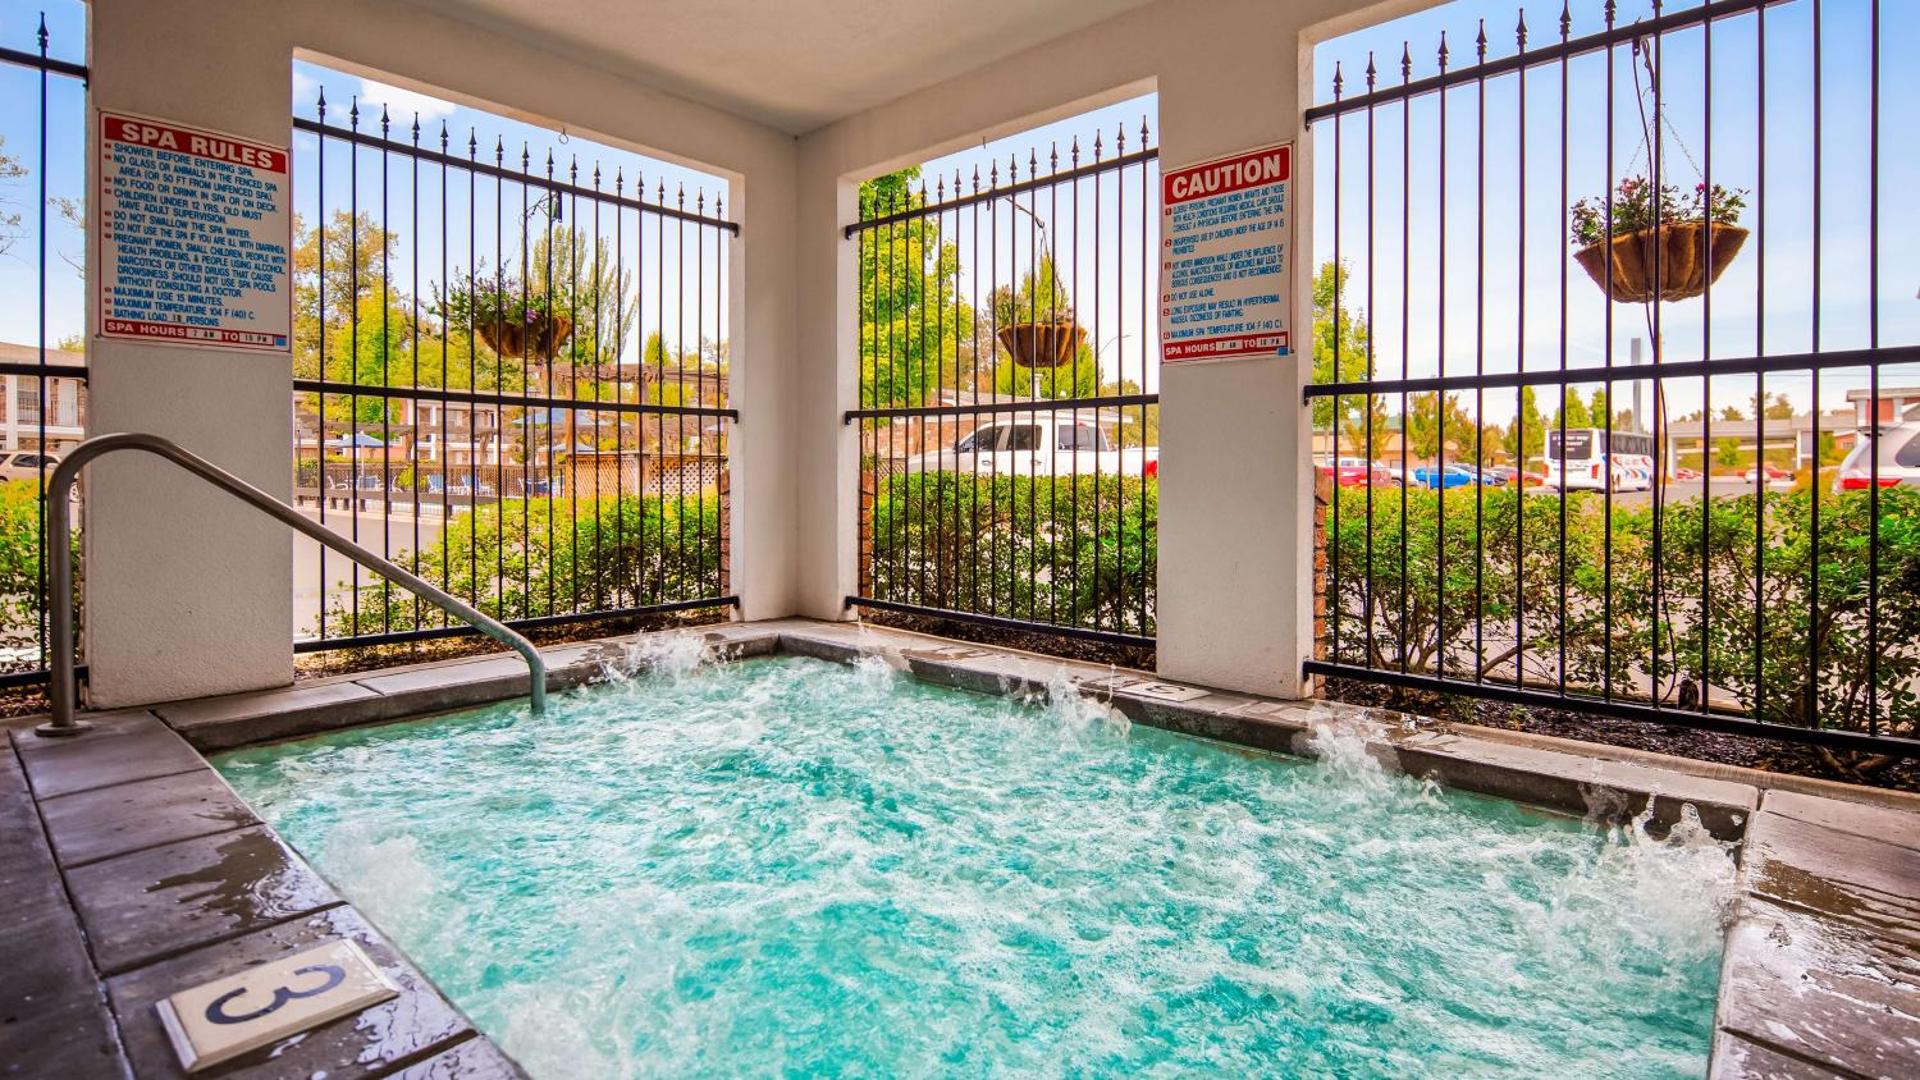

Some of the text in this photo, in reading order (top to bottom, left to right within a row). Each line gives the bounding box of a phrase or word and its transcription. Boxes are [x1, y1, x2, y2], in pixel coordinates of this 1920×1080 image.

[122, 123, 272, 168] SPA RULES
[114, 143, 153, 158] SHOWER
[157, 151, 190, 165] BEFORE
[195, 158, 234, 173] ENTERING
[114, 154, 276, 192] NO GLASS OR ANIMALS IN THE FENCED SPA
[119, 166, 141, 178] AREA
[145, 171, 159, 181] (OR
[163, 174, 174, 184] 50
[177, 176, 186, 186] FT
[189, 178, 211, 190] FROM
[215, 183, 252, 197] UNFENCED
[1172, 154, 1280, 198] CAUTION
[114, 177, 126, 186] NO
[130, 179, 154, 191] FOOD
[158, 184, 169, 194] OR
[173, 187, 196, 198] DRINK
[201, 191, 208, 200] IN
[212, 193, 225, 203] SPA
[229, 196, 240, 205] OR
[243, 199, 254, 208] ON
[114, 190, 156, 204] CHILDREN
[160, 197, 188, 208] UNDER
[193, 202, 200, 210] 12
[224, 207, 239, 217] OLD
[242, 210, 262, 220] MUST
[119, 200, 140, 211] HAVE
[144, 204, 168, 215] ADULT
[114, 210, 126, 220] DO
[130, 213, 145, 223] NOT
[149, 216, 188, 229] SWALLOW
[192, 222, 205, 232] THE
[209, 224, 223, 234] SPA
[1221, 213, 1237, 223] BEFORE
[114, 222, 124, 231] DO
[128, 224, 140, 234] NOT
[144, 226, 156, 236] USE
[161, 229, 172, 238] THE
[176, 231, 187, 240] SPA
[190, 233, 195, 241] IF
[199, 234, 211, 244] YOU
[214, 236, 224, 245] ARE
[239, 240, 253, 250] WITH
[1216, 228, 1233, 238] CHILDREN
[1235, 225, 1247, 235] UNDER
[114, 233, 152, 246] PREGNANT
[186, 243, 207, 254] SMALL
[246, 252, 268, 262] PEOPLE
[272, 255, 286, 264] WITH
[118, 244, 146, 256] HEALTH
[202, 255, 227, 266] PEOPLE
[231, 259, 251, 270] USING
[1230, 251, 1244, 260] UNDER
[1254, 245, 1276, 256] INFLUENCE
[1266, 255, 1276, 264] LEAD
[118, 255, 272, 282] NARCOTICS OR OTHER DRUGS THAT CAUSE
[118, 266, 275, 292] DROWSINESS SHOULD NOT USE SPA POOLS
[114, 287, 153, 299] MAXIMUM
[157, 291, 173, 301] USE
[177, 293, 184, 302] 15
[118, 276, 152, 288] WITHOUT
[156, 280, 201, 293] CONSULTING
[114, 298, 151, 310] MAXIMUM
[156, 302, 206, 315] TEMPERATURE
[210, 308, 221, 316] 104
[232, 310, 246, 319] (40)
[114, 309, 144, 320] BATHING
[148, 312, 166, 322] LOAD
[1184, 303, 1206, 313] EXPOSURE
[1208, 302, 1217, 310] MAY
[1218, 299, 1235, 309] RESULT
[107, 321, 133, 332] SPA
[140, 324, 184, 337] HOURS
[223, 332, 238, 341] TO
[1171, 329, 1193, 338] MAXIMUM
[1207, 324, 1243, 334] TEMPERATURE
[1166, 346, 1182, 355] SPA
[1185, 343, 1215, 353] HOURS
[205, 964, 346, 1024] 3
